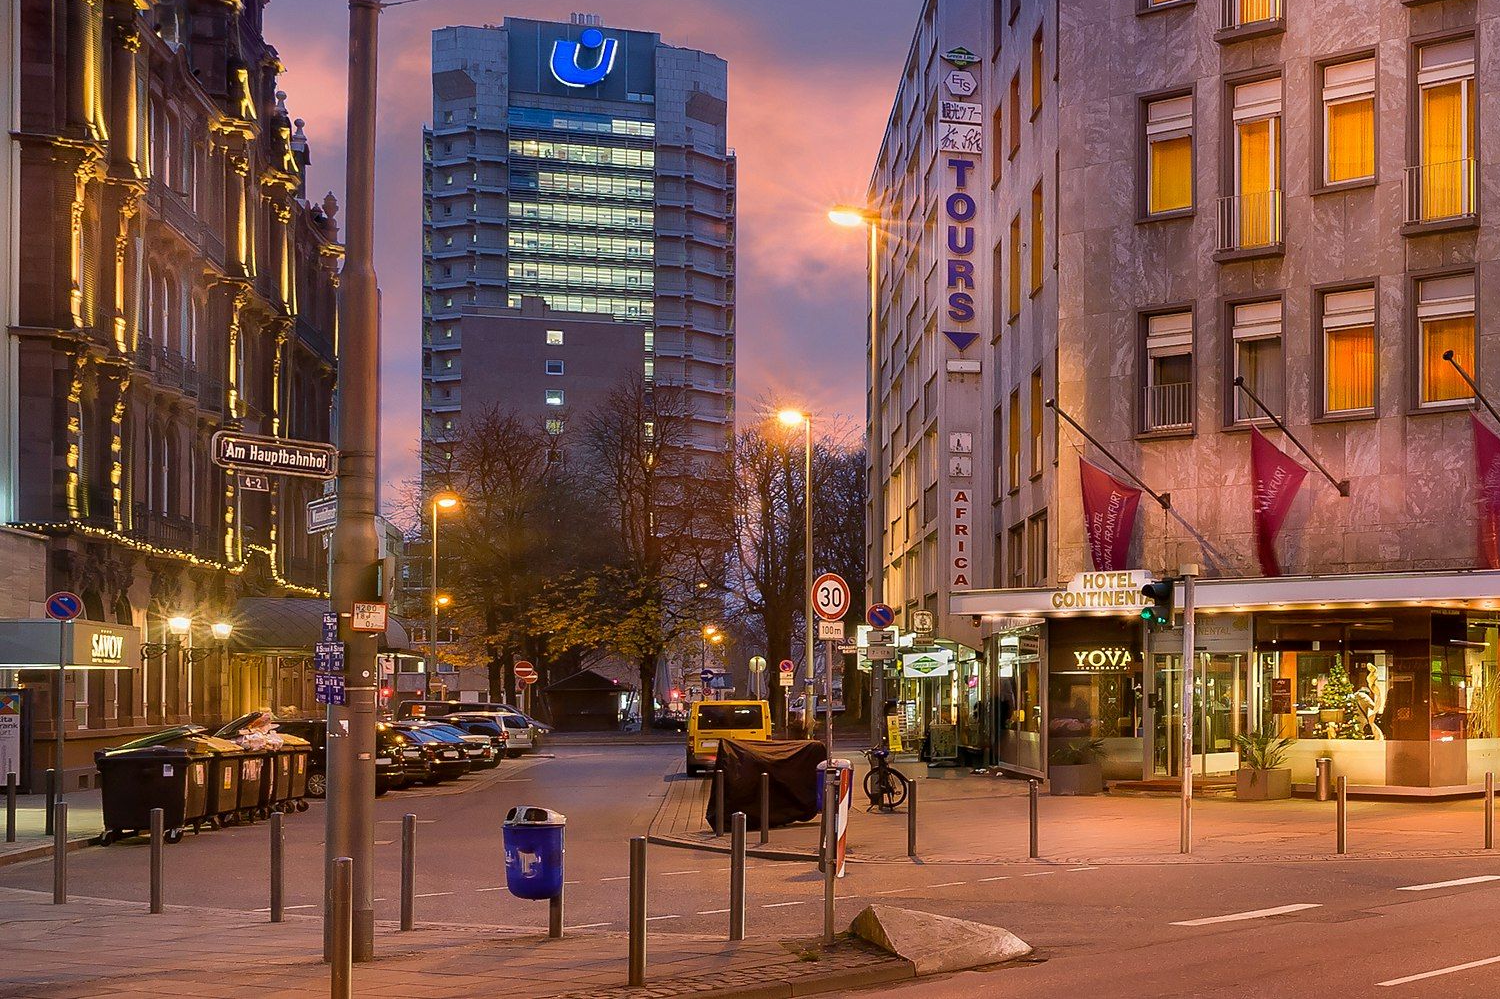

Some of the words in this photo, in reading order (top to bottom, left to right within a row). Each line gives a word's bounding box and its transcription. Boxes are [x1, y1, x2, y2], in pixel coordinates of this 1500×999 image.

[952, 74, 971, 92] ETS
[946, 158, 976, 323] TOURS
[226, 442, 246, 459] Am
[250, 444, 327, 469] Hauptbahnhof
[245, 476, 262, 489] 4-2
[1093, 512, 1104, 539] HOTEL
[1104, 490, 1122, 543] FRANKFURT
[953, 491, 969, 586] AFRICA
[1083, 572, 1137, 589] HOTEL
[820, 587, 842, 607] 30
[1052, 589, 1156, 608] CONTINENTA
[822, 625, 834, 635] 100
[834, 627, 842, 635] m
[92, 633, 123, 659] SAVOY
[1073, 649, 1132, 667] YOVA
